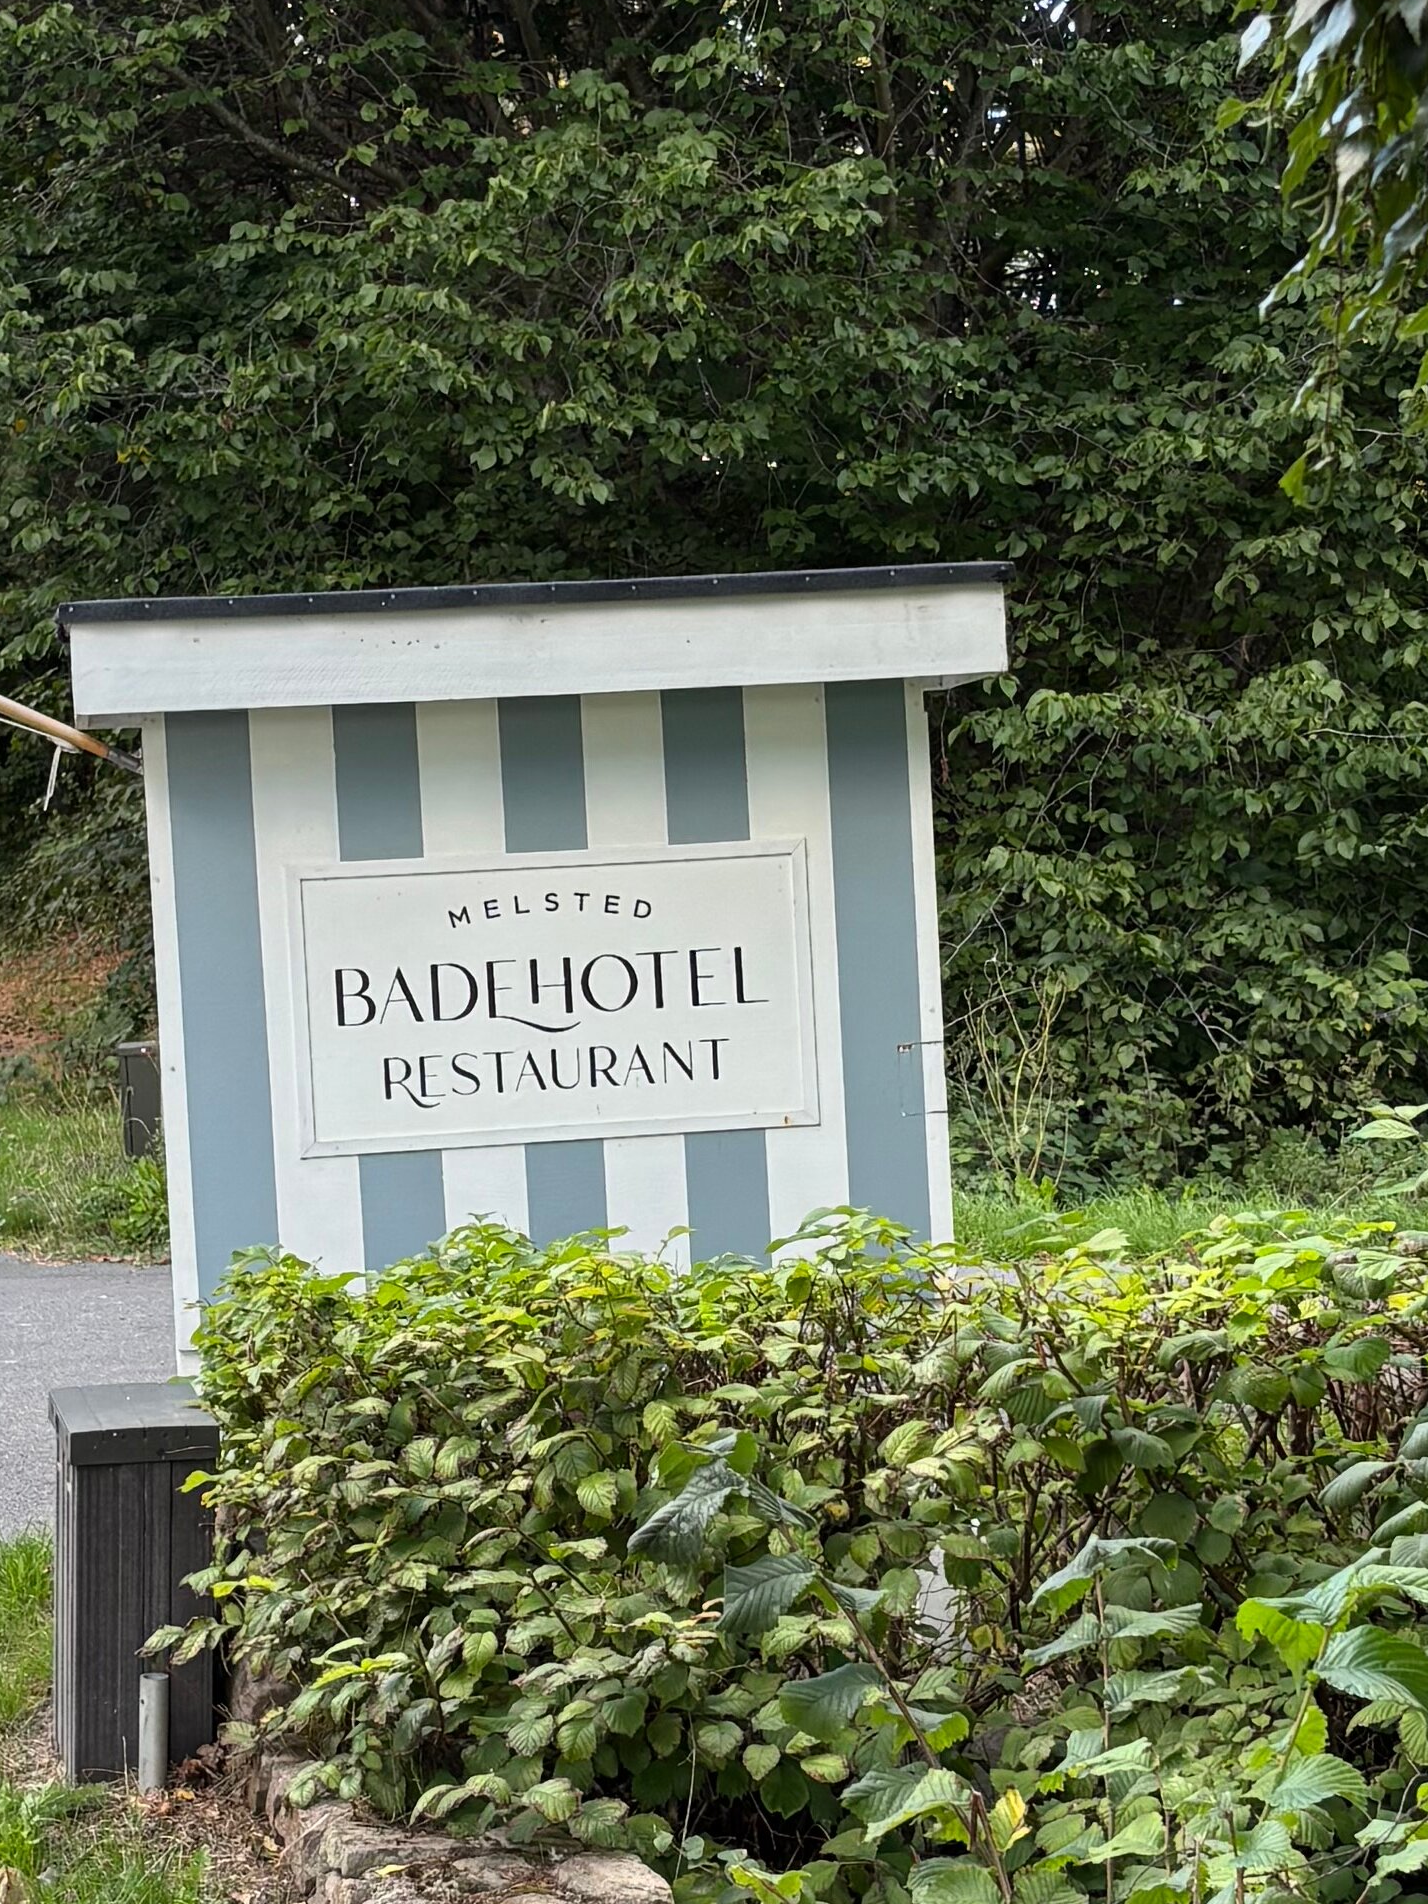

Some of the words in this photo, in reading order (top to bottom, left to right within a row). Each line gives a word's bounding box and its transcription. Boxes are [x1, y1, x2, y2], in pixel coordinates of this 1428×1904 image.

[448, 892, 652, 928] MELSTED
[334, 946, 770, 1033] BADEHOTEL
[383, 1038, 730, 1109] RESTAURANT
